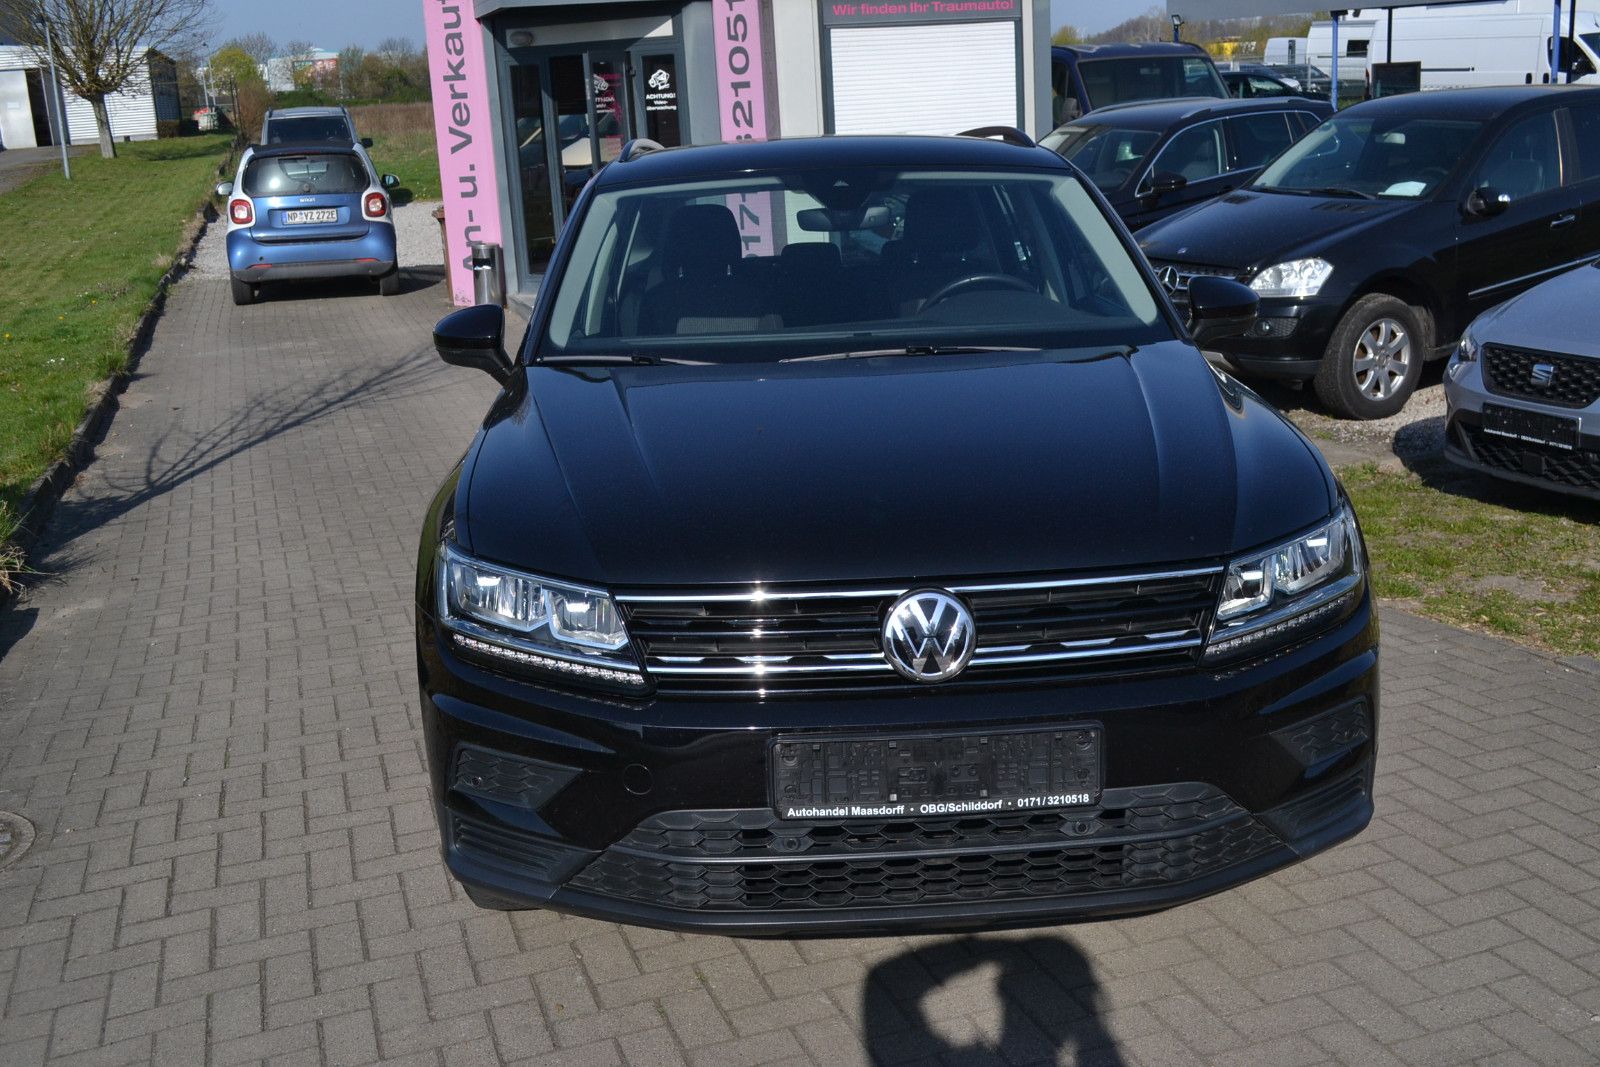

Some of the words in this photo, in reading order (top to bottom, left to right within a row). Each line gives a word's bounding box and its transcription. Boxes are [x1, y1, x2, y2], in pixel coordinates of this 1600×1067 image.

[833, 4, 857, 16] Wir
[861, 3, 907, 16] finden
[910, 1, 930, 14] Ihr
[932, 0, 1015, 12] Traumauto!
[442, 0, 473, 155] Verkau
[459, 164, 478, 198] u.
[287, 212, 298, 222] NP
[316, 210, 336, 220] 272E
[787, 806, 849, 817] Autohandel
[851, 805, 905, 816] Maasdorff
[919, 800, 1003, 814] OBG/Schilddorf
[1017, 793, 1090, 808] 0171/3210518
